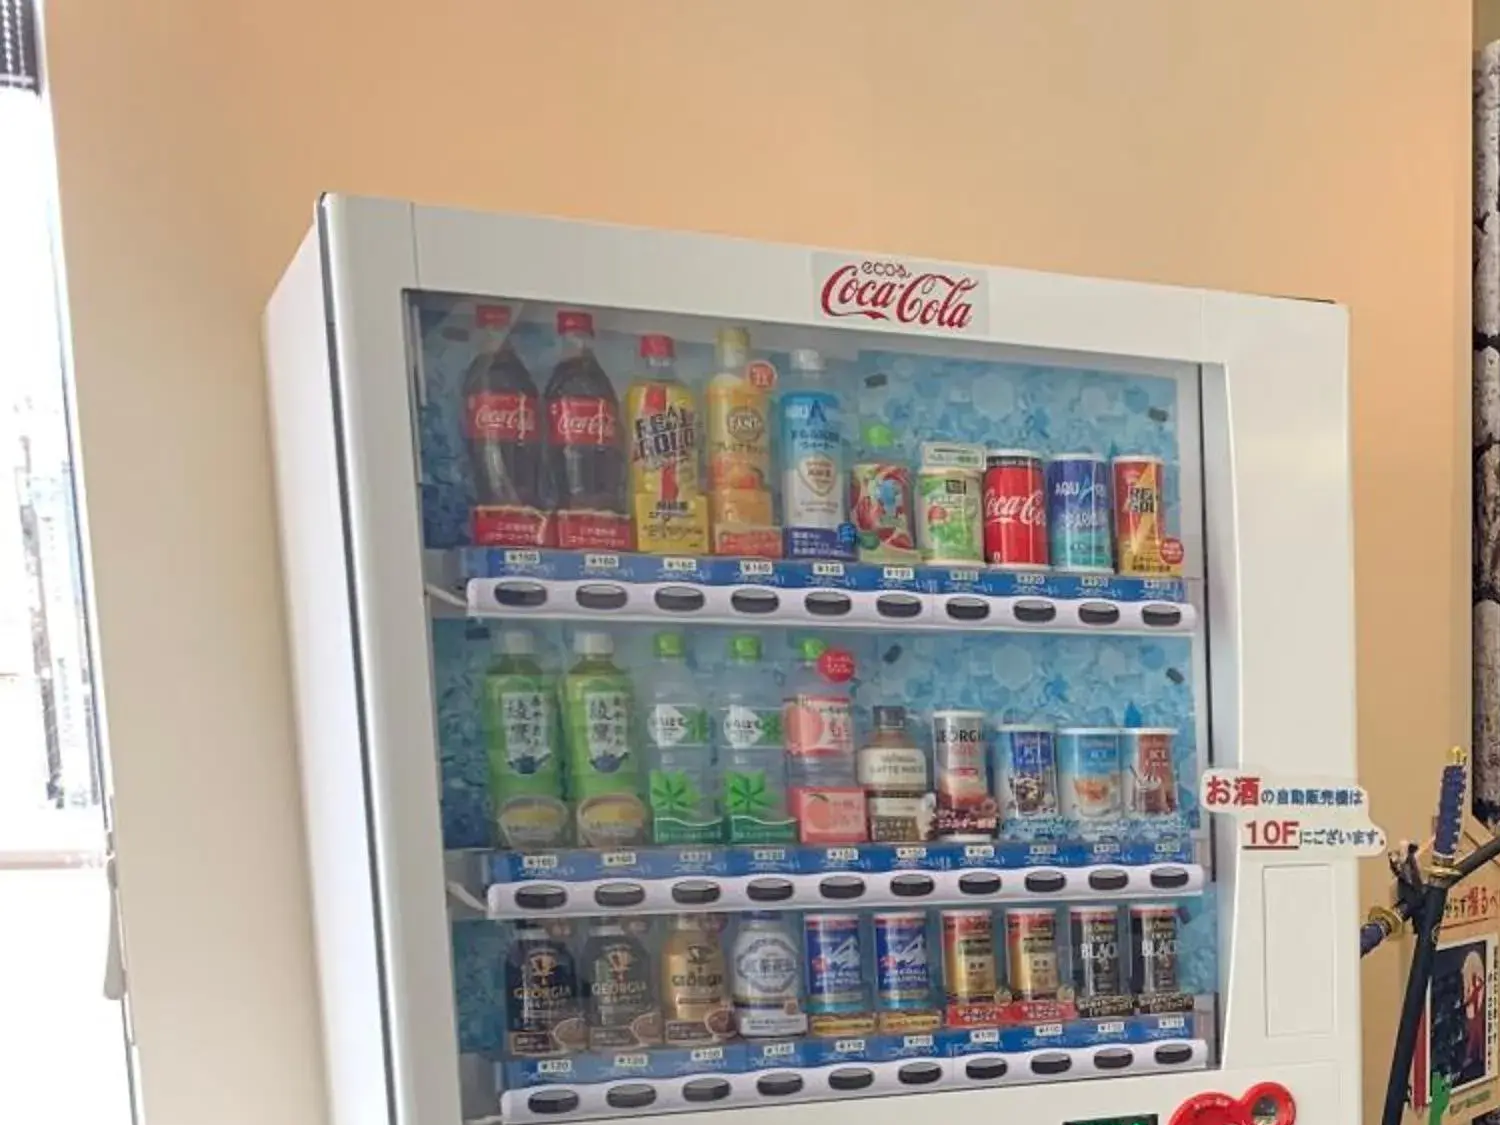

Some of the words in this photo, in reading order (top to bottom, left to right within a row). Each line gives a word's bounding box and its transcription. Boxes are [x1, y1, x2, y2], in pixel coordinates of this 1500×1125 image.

[821, 264, 979, 329] Coca-Cola
[1205, 775, 1365, 807] お酒の自動販売機は
[513, 984, 572, 1000] GEORGIA
[590, 980, 648, 996] GEORGIA
